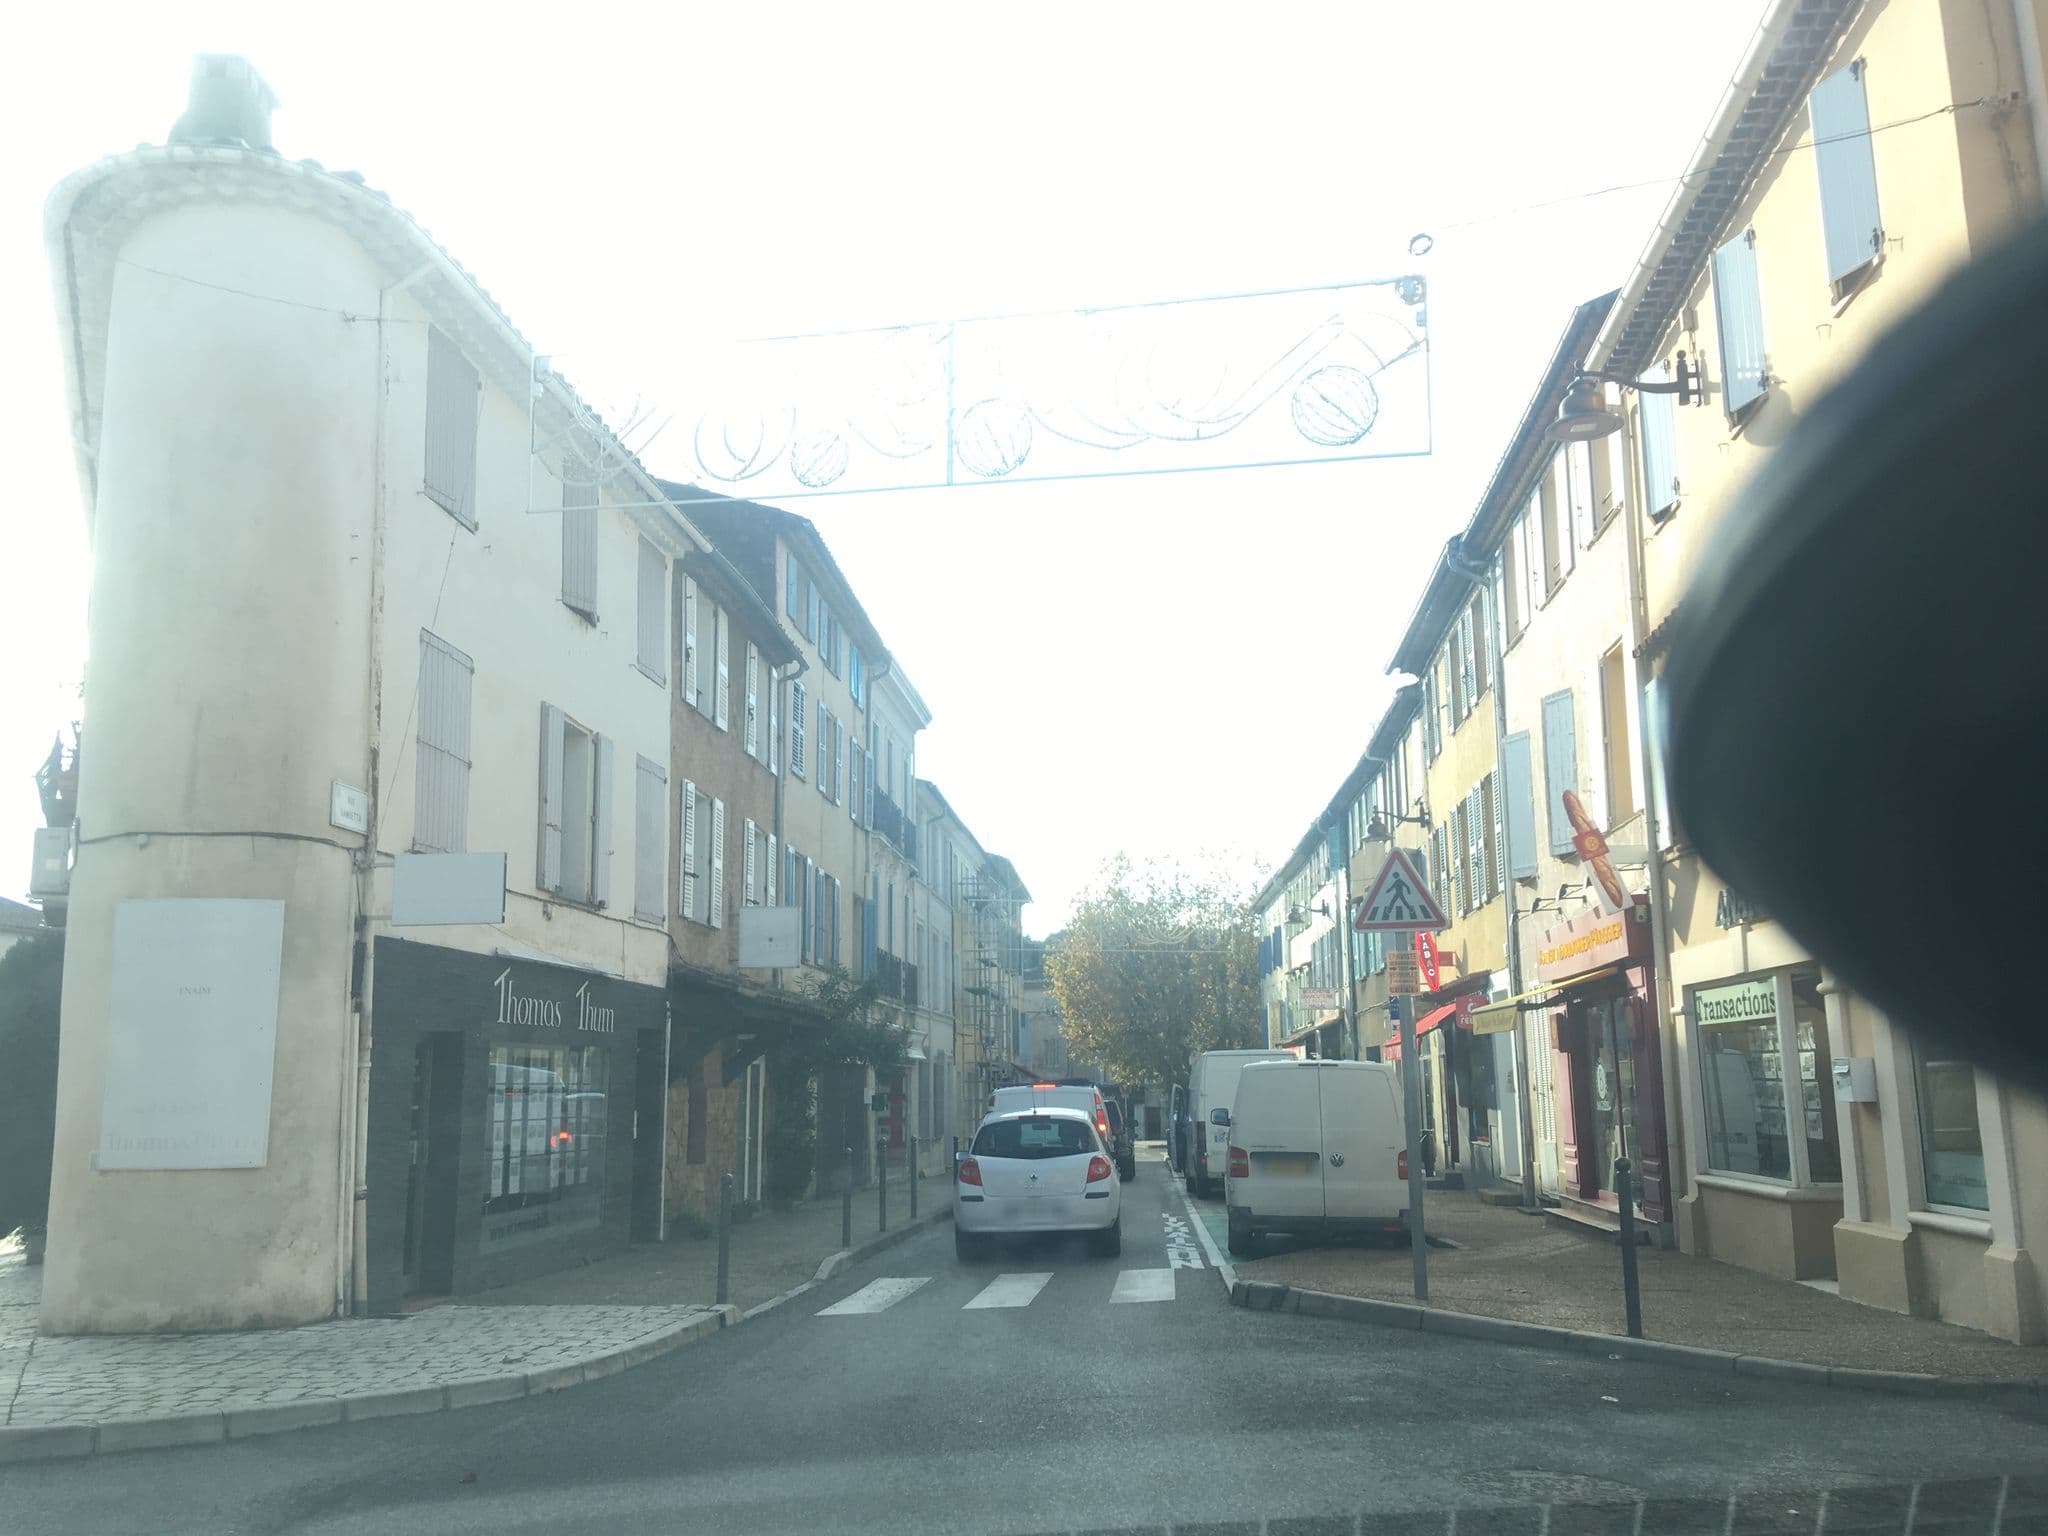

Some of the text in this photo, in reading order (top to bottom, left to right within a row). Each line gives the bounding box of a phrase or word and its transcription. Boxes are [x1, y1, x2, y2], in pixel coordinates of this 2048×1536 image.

[1419, 932, 1436, 978] TABAC
[494, 966, 615, 1034] Thomas Thum
[1696, 986, 1777, 1022] Transactions
